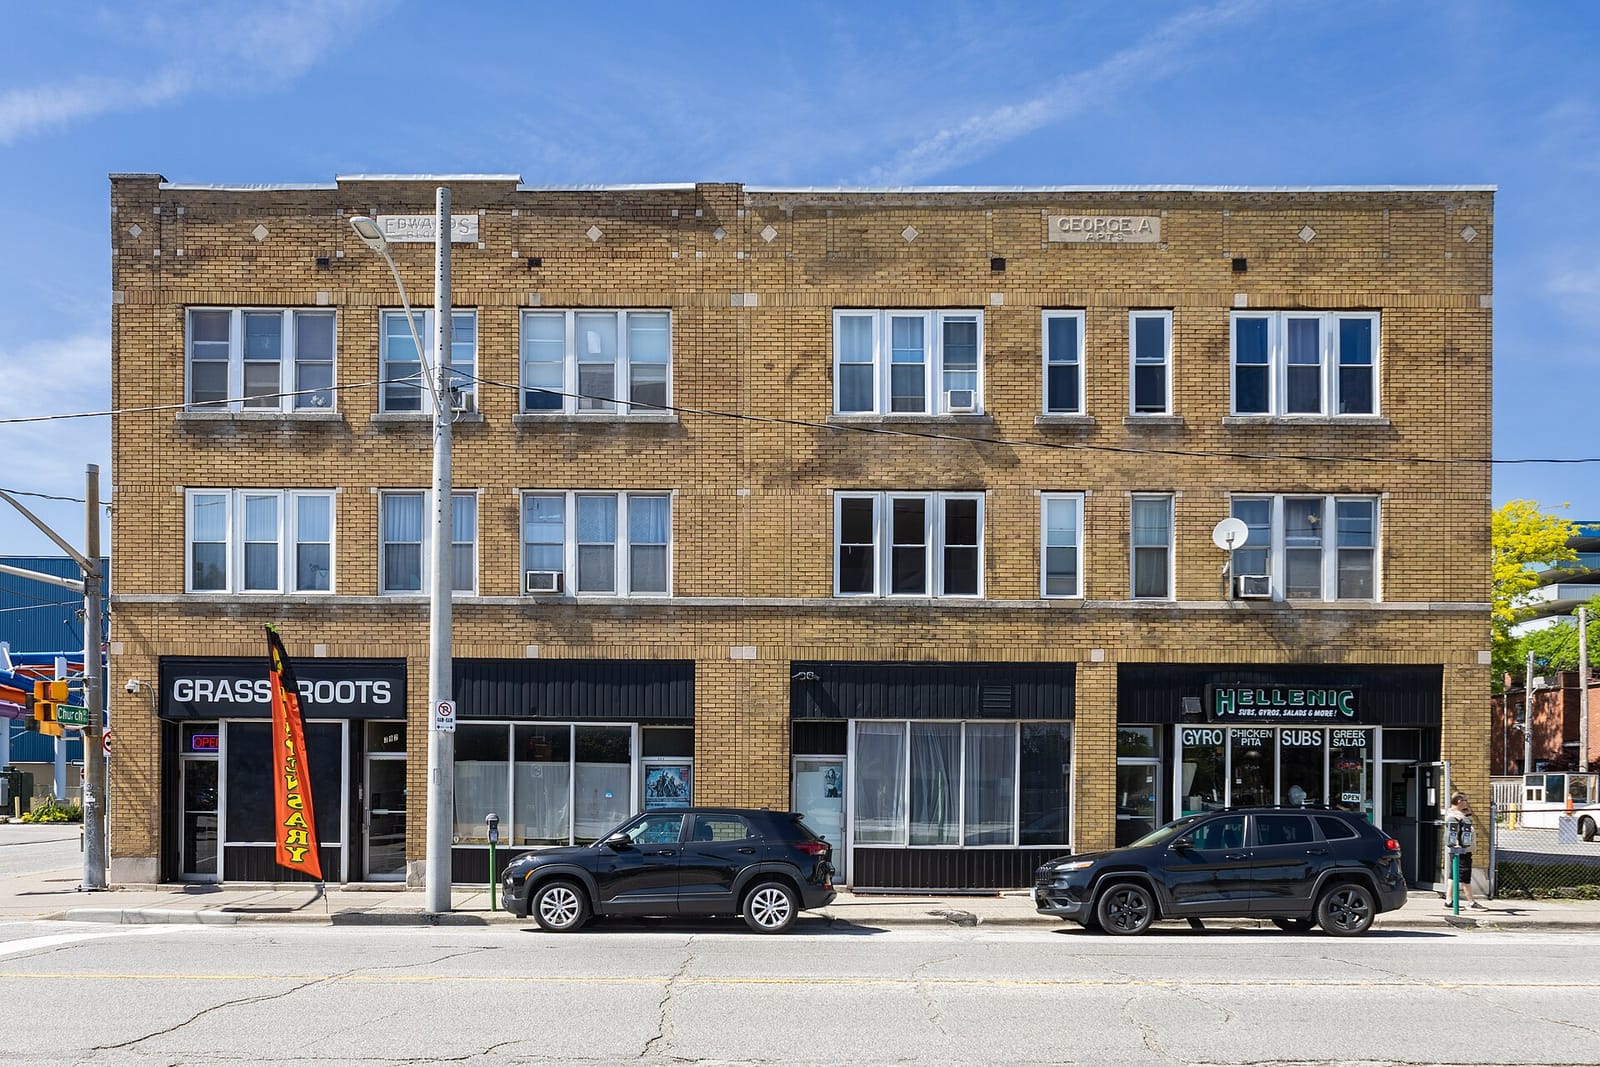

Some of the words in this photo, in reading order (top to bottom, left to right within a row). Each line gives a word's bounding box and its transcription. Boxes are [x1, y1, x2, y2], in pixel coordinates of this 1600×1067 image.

[385, 218, 470, 234] EDWADS
[1085, 231, 1125, 241] APTS
[173, 679, 272, 703] GRASS
[297, 680, 392, 704] ROOTS
[1215, 688, 1354, 717] HELLENIC
[57, 707, 83, 721] Church
[1238, 708, 1257, 717] SUBS,
[1258, 709, 1282, 717] GYROS,
[1282, 709, 1307, 717] SALADS
[1308, 709, 1313, 717] &
[1182, 729, 1223, 745] GYRO
[1230, 729, 1273, 738] CHICKEN
[1281, 730, 1322, 746] SUBS
[1333, 730, 1366, 738] GREEK
[1240, 738, 1261, 746] PITA
[1333, 738, 1366, 747] SALAD
